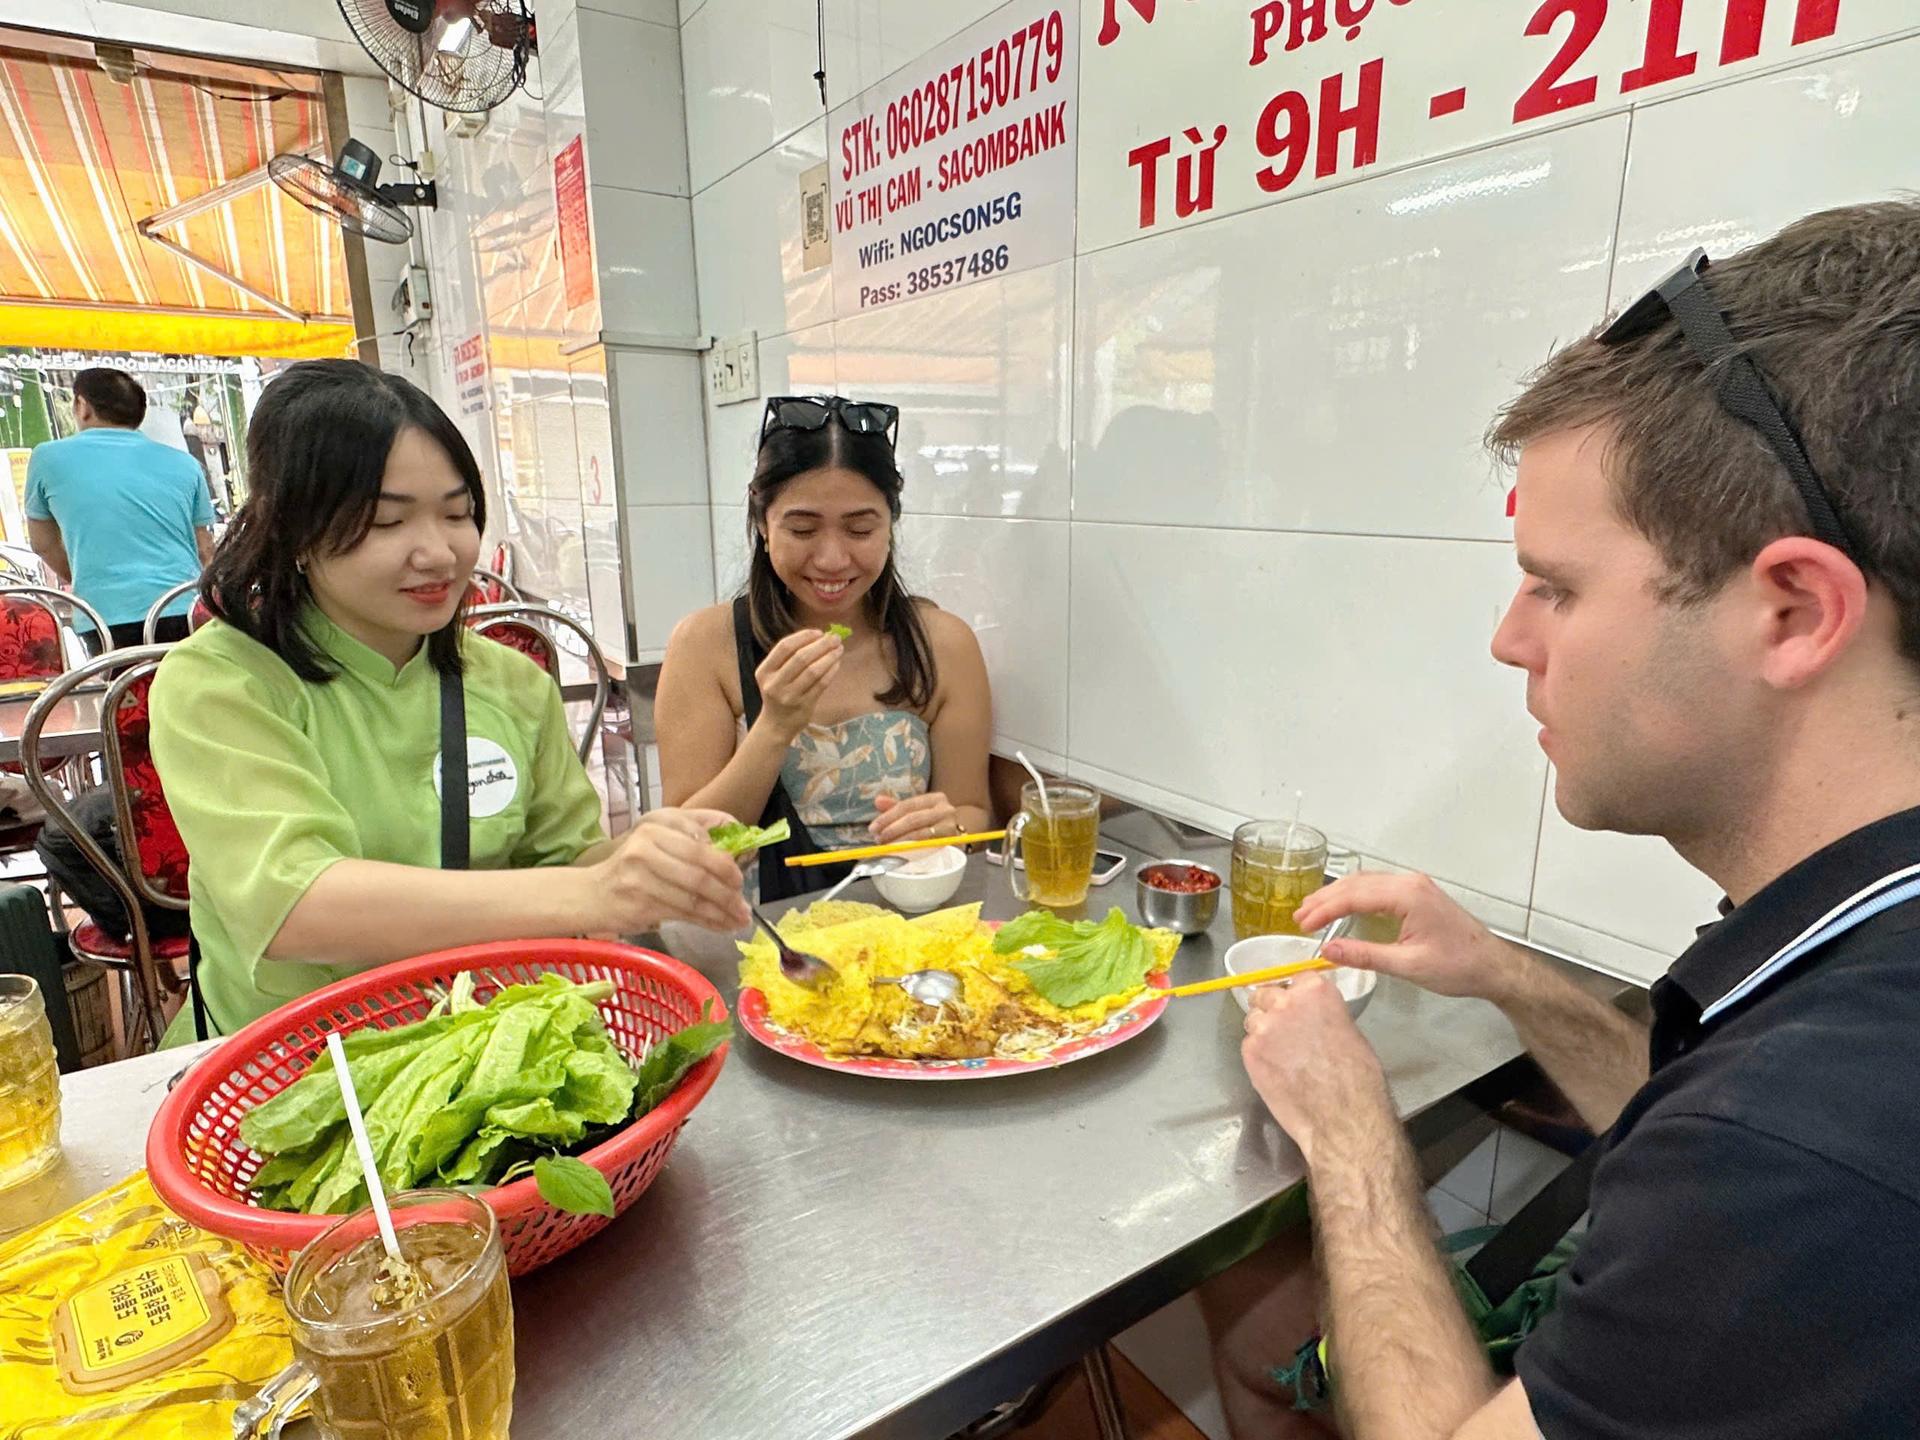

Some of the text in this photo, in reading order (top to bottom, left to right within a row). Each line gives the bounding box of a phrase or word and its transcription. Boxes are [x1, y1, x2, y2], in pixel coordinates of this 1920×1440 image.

[1249, 0, 1412, 66] PHỤ
[841, 113, 881, 182] STK:
[886, 9, 1063, 160] 060287150779
[1128, 124, 1227, 229] Từ
[1255, 57, 1384, 193] 9H
[835, 188, 853, 233] VŨ
[858, 183, 882, 226] THỊ
[887, 166, 921, 213] CAM
[938, 100, 1066, 192] SACOMBANK
[859, 191, 1022, 269] Wifi: NGOCSON5G
[860, 244, 1009, 308] Pass: 38537486
